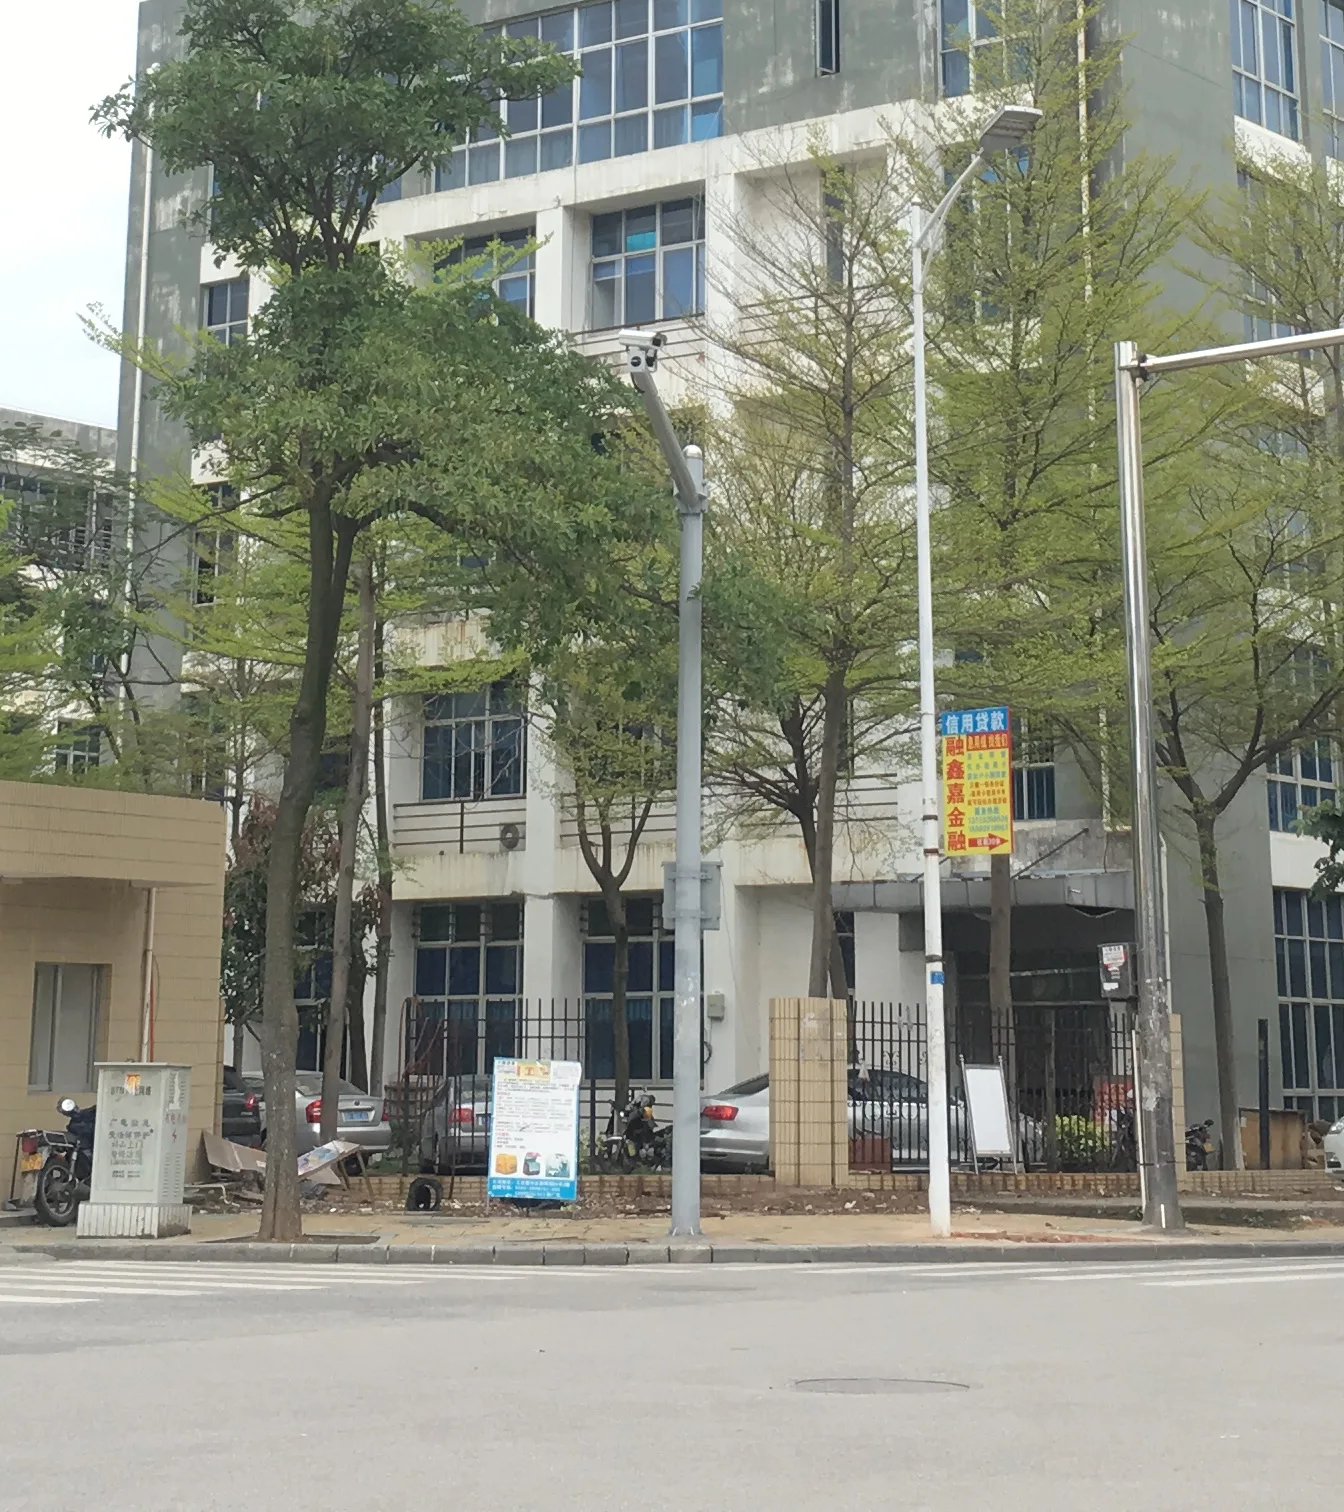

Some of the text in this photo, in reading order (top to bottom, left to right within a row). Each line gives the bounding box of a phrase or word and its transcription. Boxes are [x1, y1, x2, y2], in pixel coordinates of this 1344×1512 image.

[946, 711, 1005, 734] 信用贷款
[945, 736, 966, 852] 融鑫嘉金融
